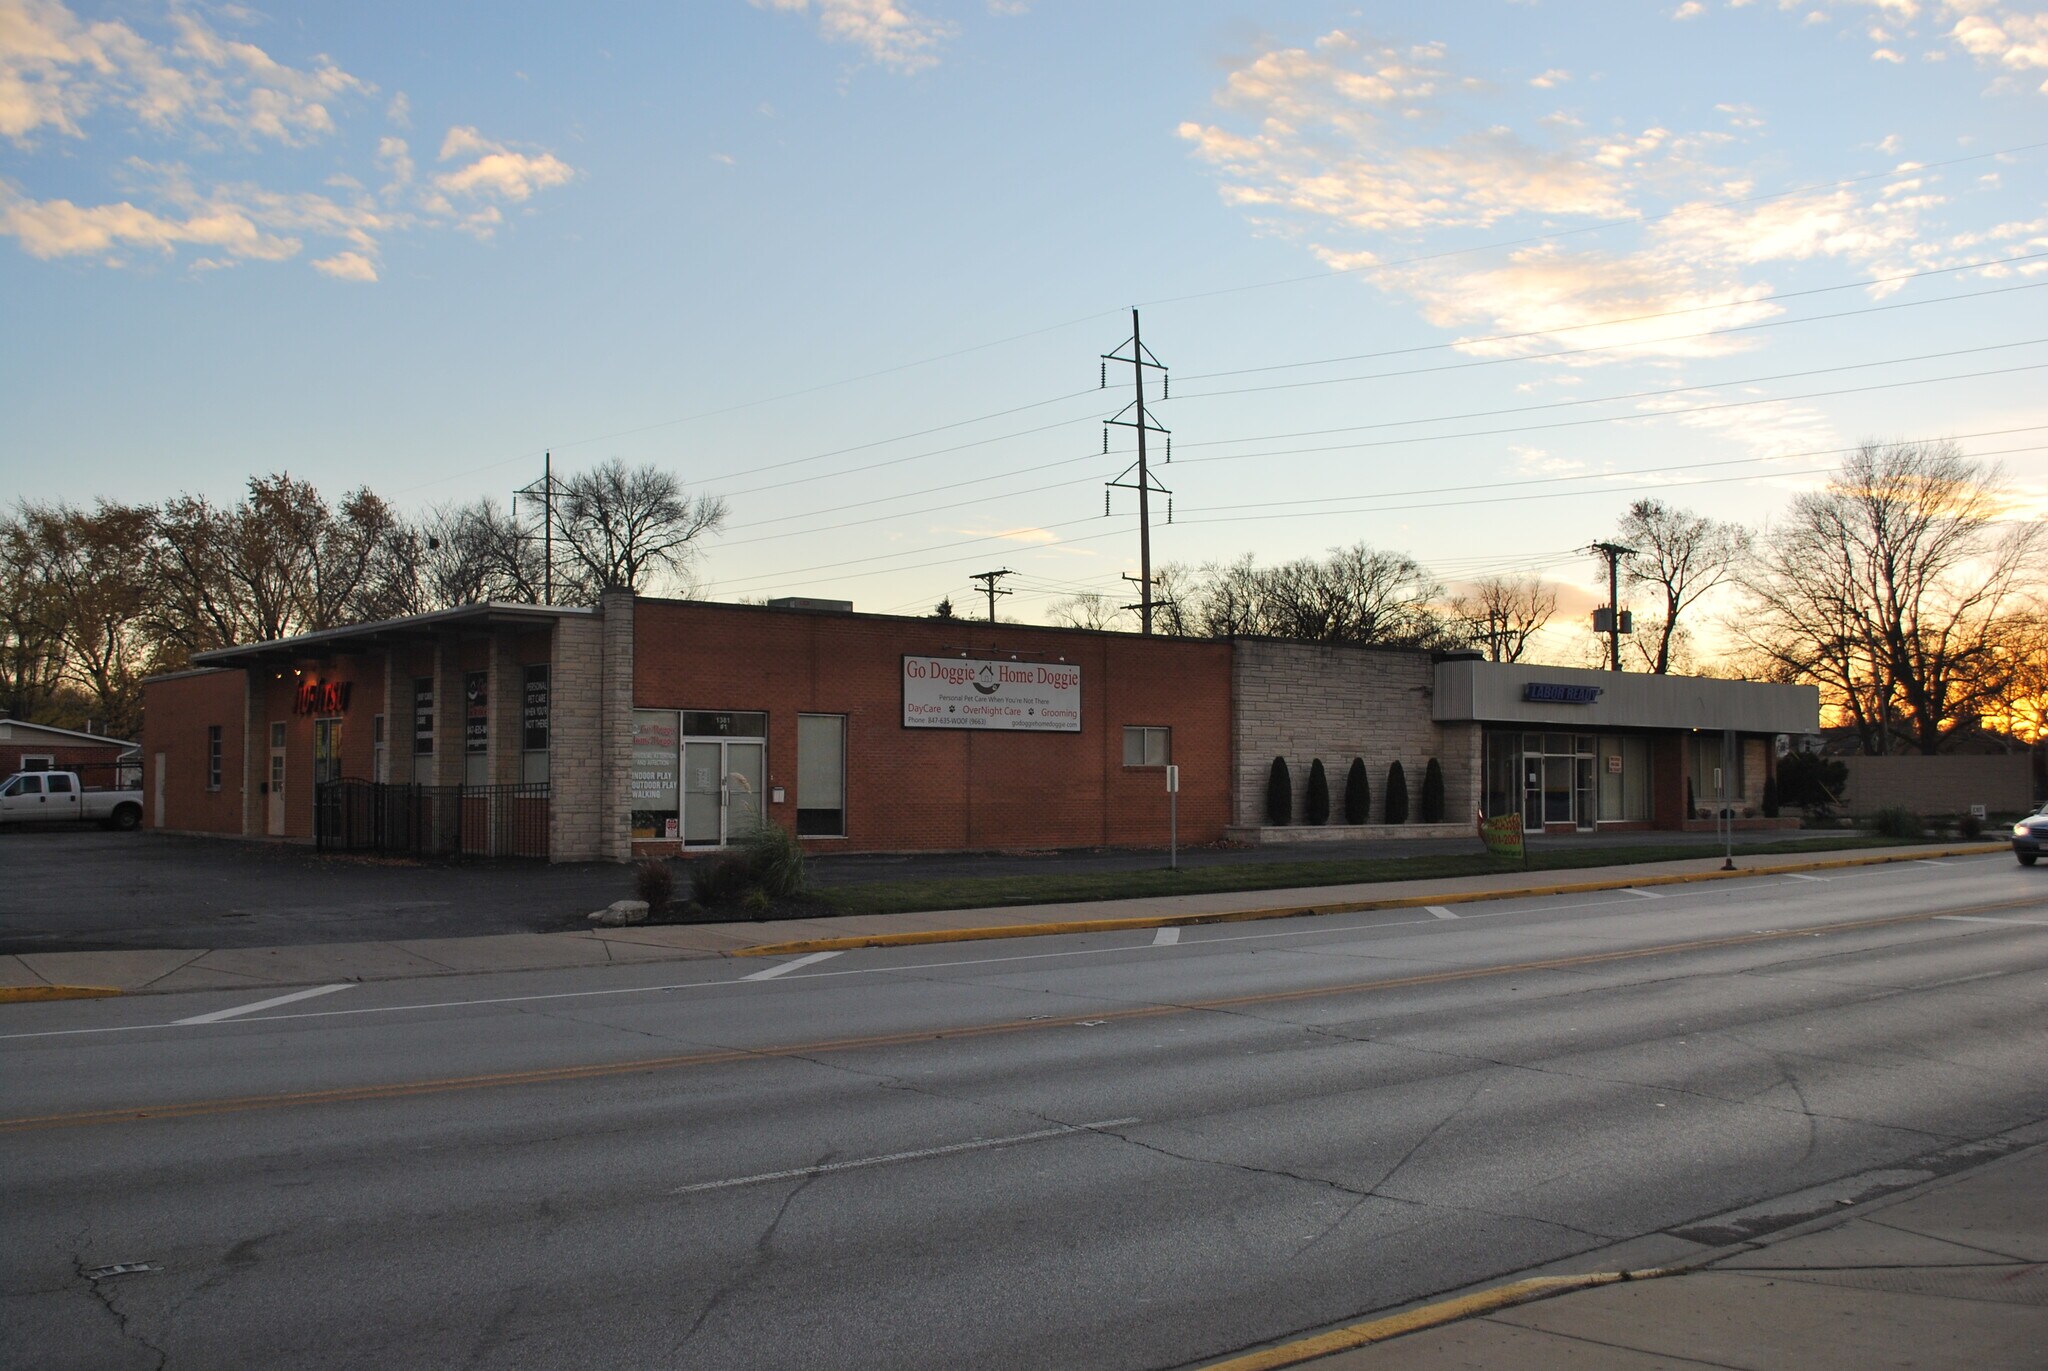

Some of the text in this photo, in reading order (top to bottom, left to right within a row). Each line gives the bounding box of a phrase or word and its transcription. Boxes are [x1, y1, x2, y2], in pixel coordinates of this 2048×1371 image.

[907, 660, 975, 684] Go Doggie
[999, 665, 1079, 689] Home Doggie
[1531, 686, 1598, 701] LABOR READY
[1035, 697, 1050, 705] There
[908, 703, 1078, 720] DayCare OverNight Care Grooming
[928, 716, 968, 724] 847-635-WOOF
[969, 717, 986, 726] (9663)
[632, 772, 672, 780] INDOOR PLAY
[632, 781, 678, 789] OUTDOOR PLAY
[632, 790, 661, 799] WALKING
